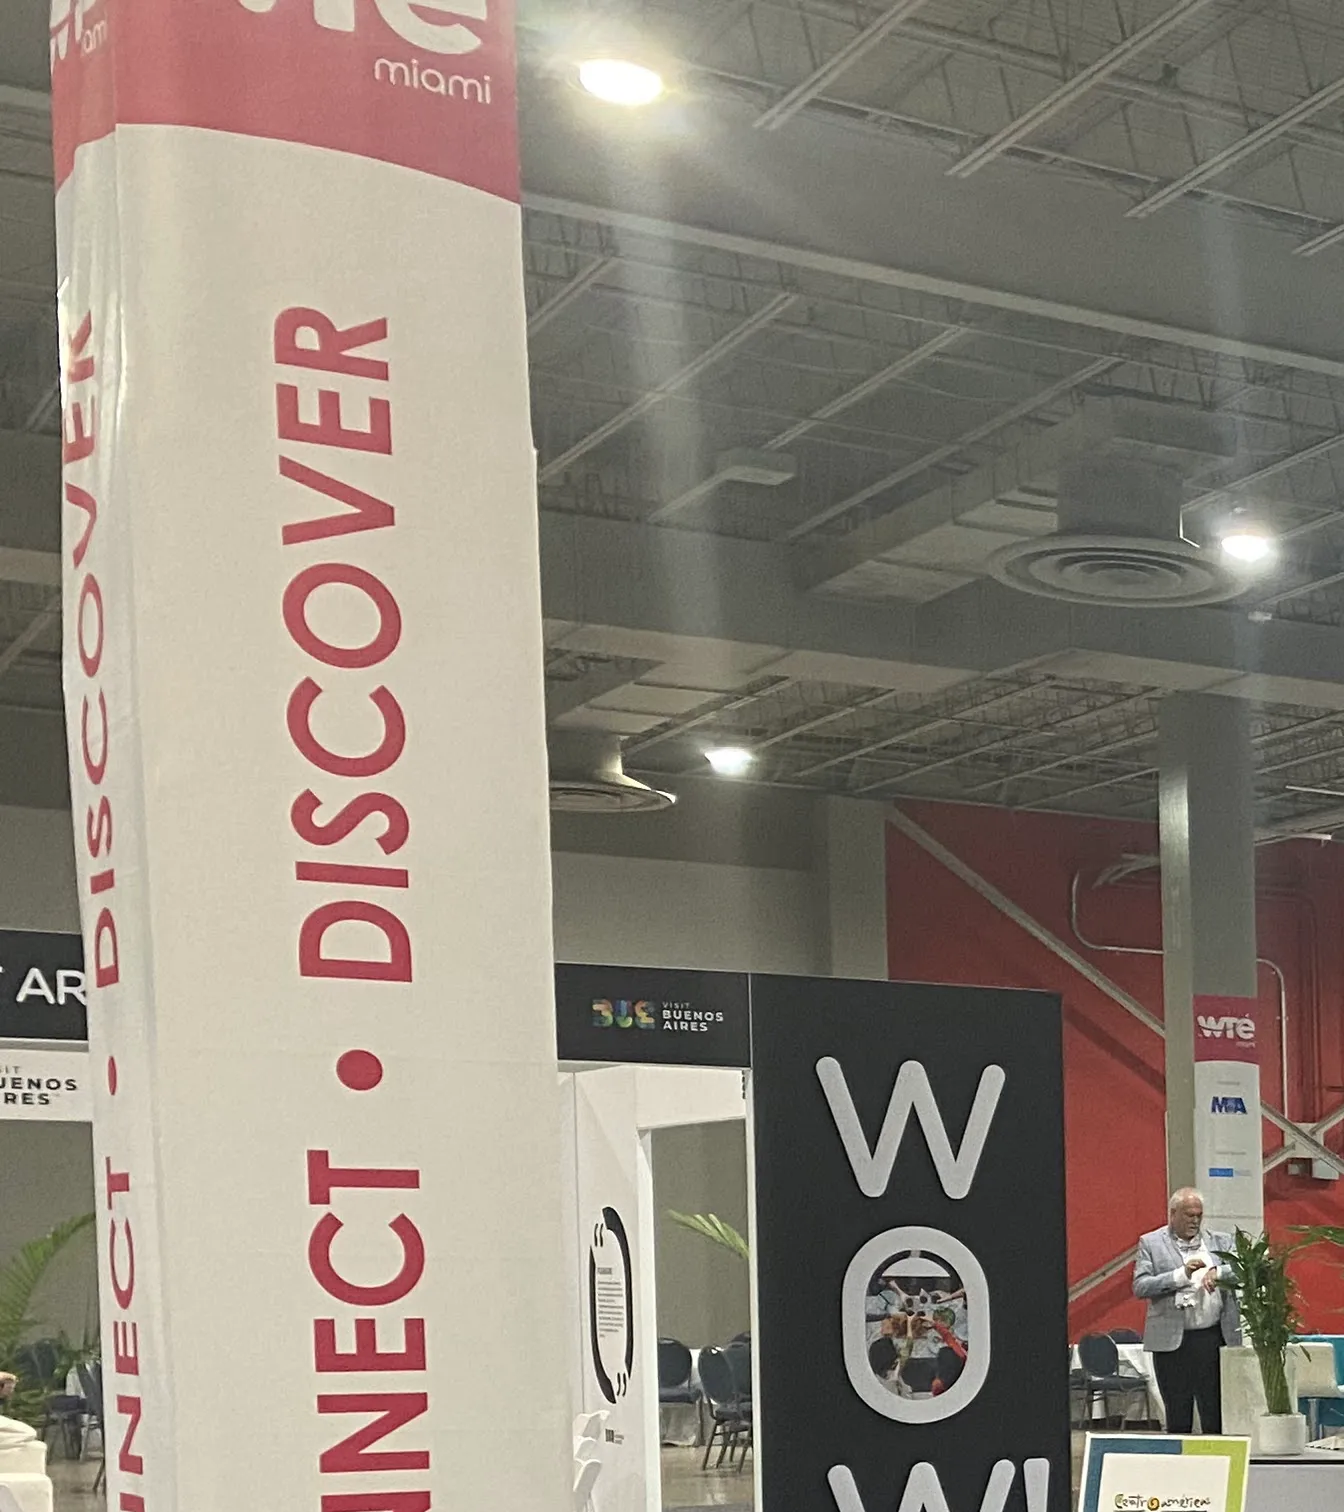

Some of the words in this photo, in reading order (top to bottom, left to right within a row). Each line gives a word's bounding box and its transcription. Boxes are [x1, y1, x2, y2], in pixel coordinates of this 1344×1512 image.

[374, 57, 492, 104] miami
[274, 306, 413, 983] DISCOVER
[662, 1001, 690, 1009] VISIT
[662, 1010, 724, 1022] BUENOS
[662, 1021, 708, 1032] AIRES
